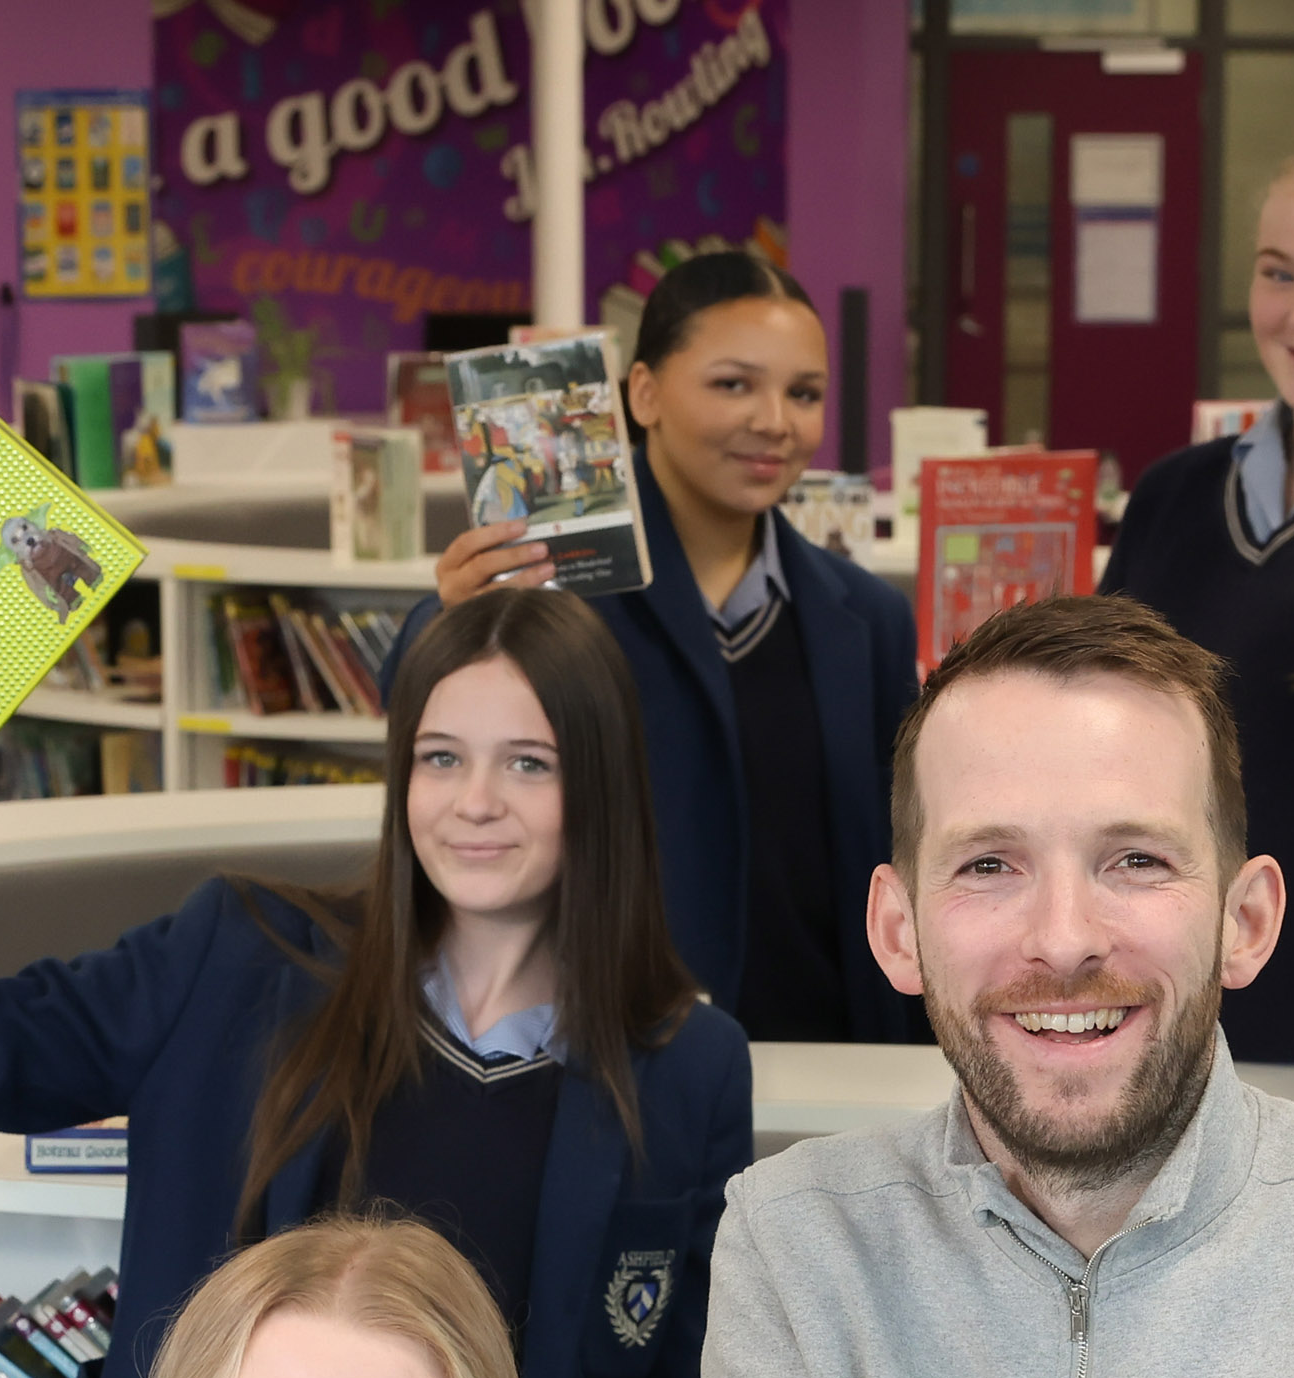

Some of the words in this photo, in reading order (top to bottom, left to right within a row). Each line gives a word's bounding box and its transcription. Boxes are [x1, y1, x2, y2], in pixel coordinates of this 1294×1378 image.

[180, 111, 249, 185] a
[265, 9, 519, 194] good
[598, 10, 770, 163] Rowling
